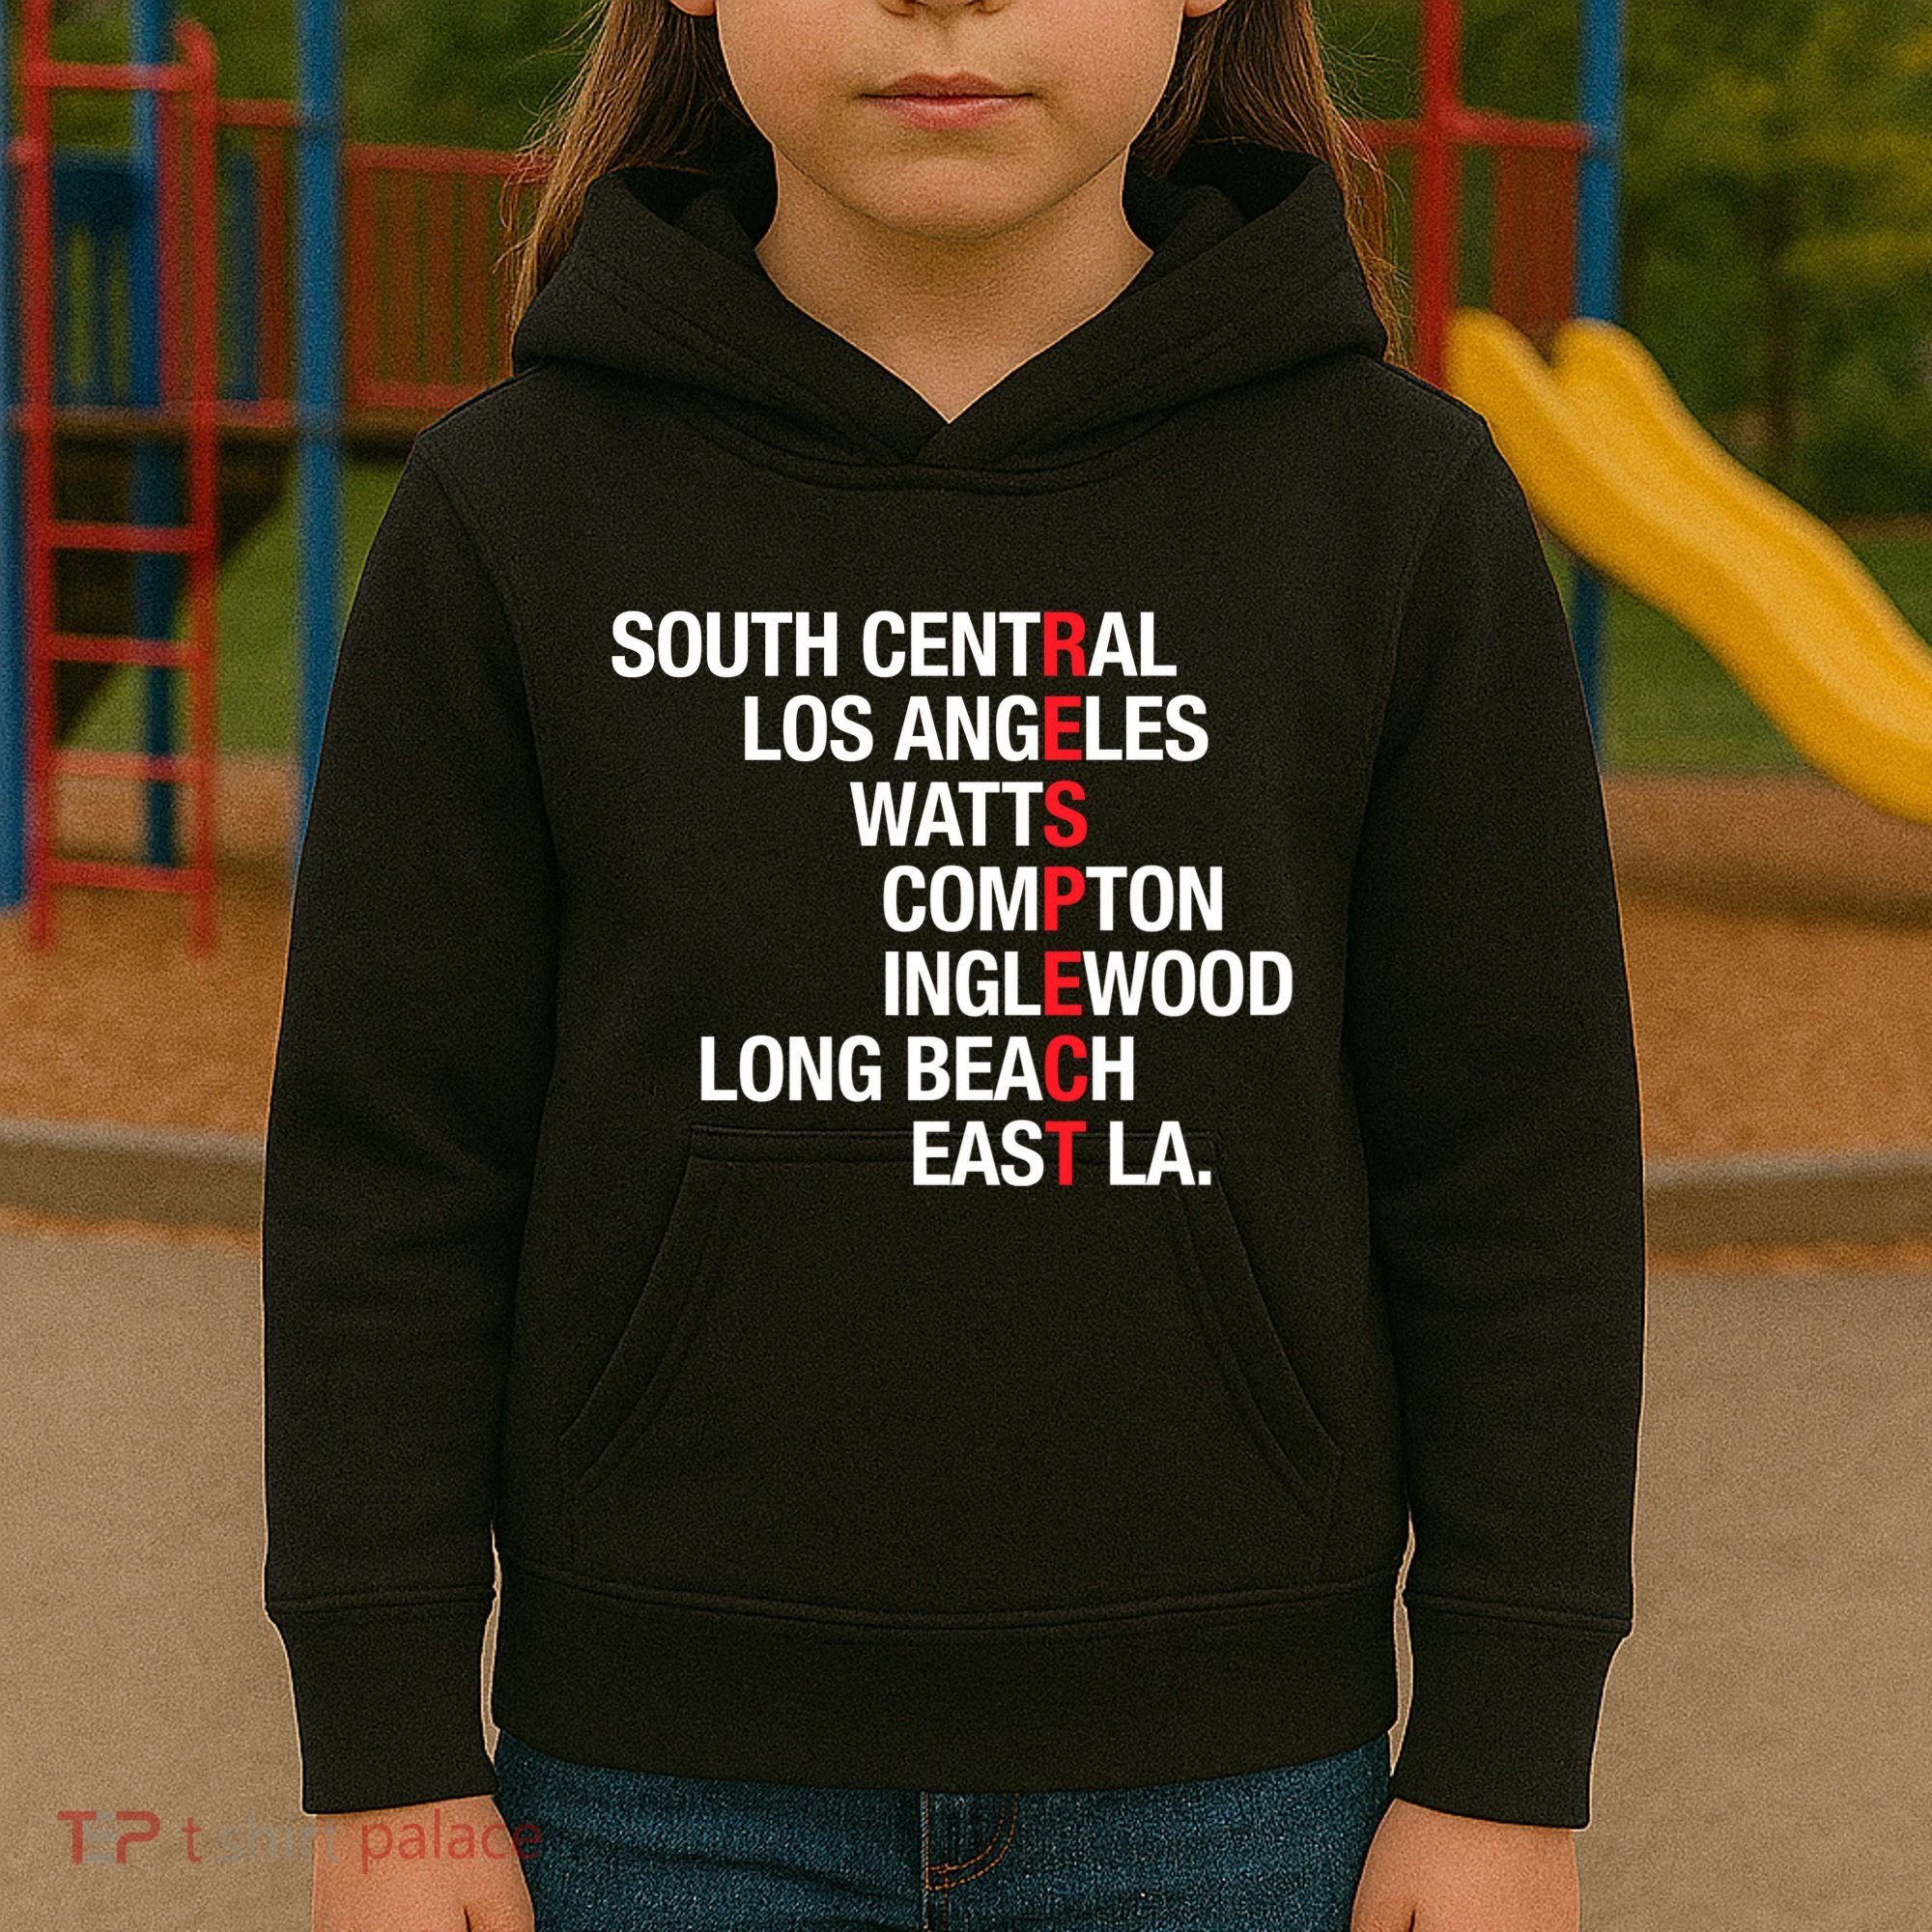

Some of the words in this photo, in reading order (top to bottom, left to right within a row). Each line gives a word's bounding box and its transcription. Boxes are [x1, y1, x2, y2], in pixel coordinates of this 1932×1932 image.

[611, 611, 838, 677] SOUTH
[863, 611, 1177, 677] CENTRAL
[745, 695, 873, 761] LOS
[895, 695, 1208, 761] ANGELES
[850, 781, 1088, 847] WATTS
[883, 866, 1222, 932] COMPTON
[885, 950, 1293, 1016] INGLEWOOD
[700, 1035, 881, 1102] LONG
[907, 1035, 1134, 1102] BEACH
[913, 1120, 1086, 1186] EAST
[1110, 1120, 1210, 1186] LA.
